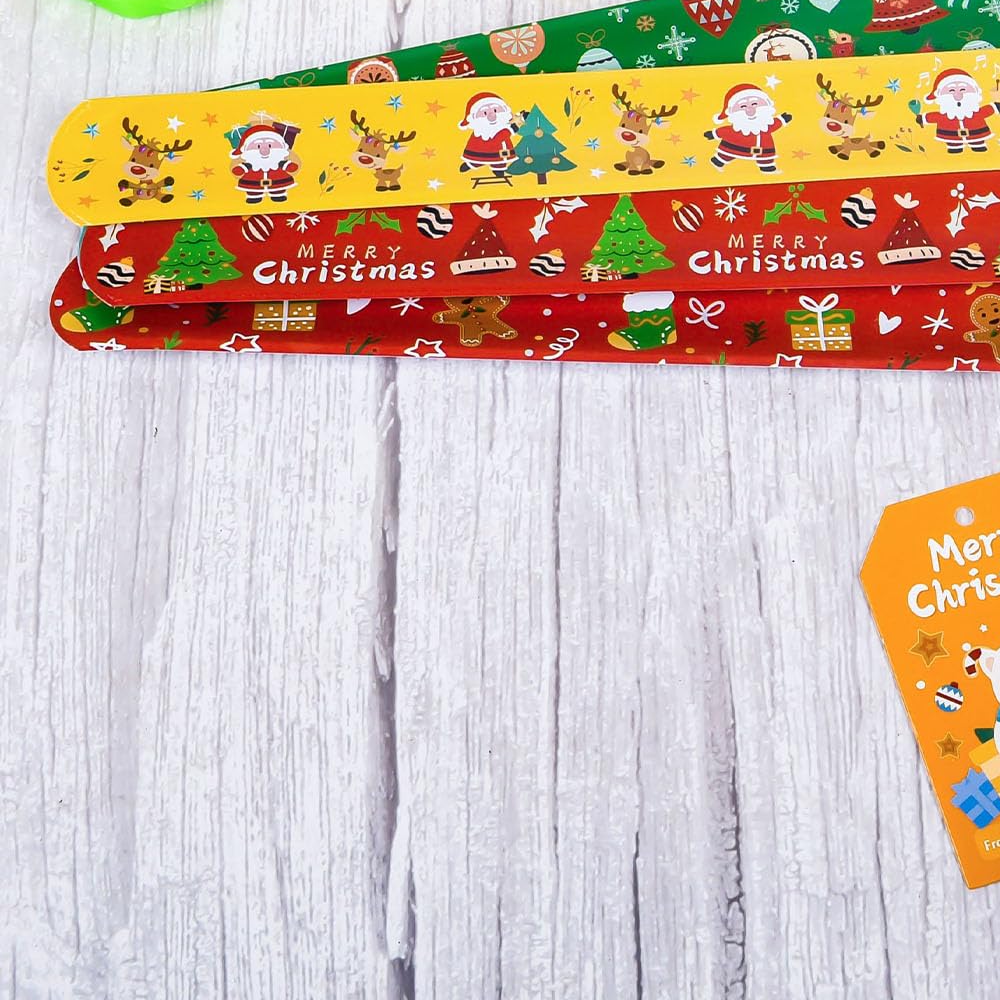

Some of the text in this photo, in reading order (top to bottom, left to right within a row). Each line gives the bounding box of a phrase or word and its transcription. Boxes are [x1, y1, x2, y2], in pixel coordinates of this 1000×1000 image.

[297, 244, 402, 260] MERRY
[728, 233, 828, 250] MERRY
[689, 249, 864, 274] Christmas
[252, 260, 436, 285] Christmas
